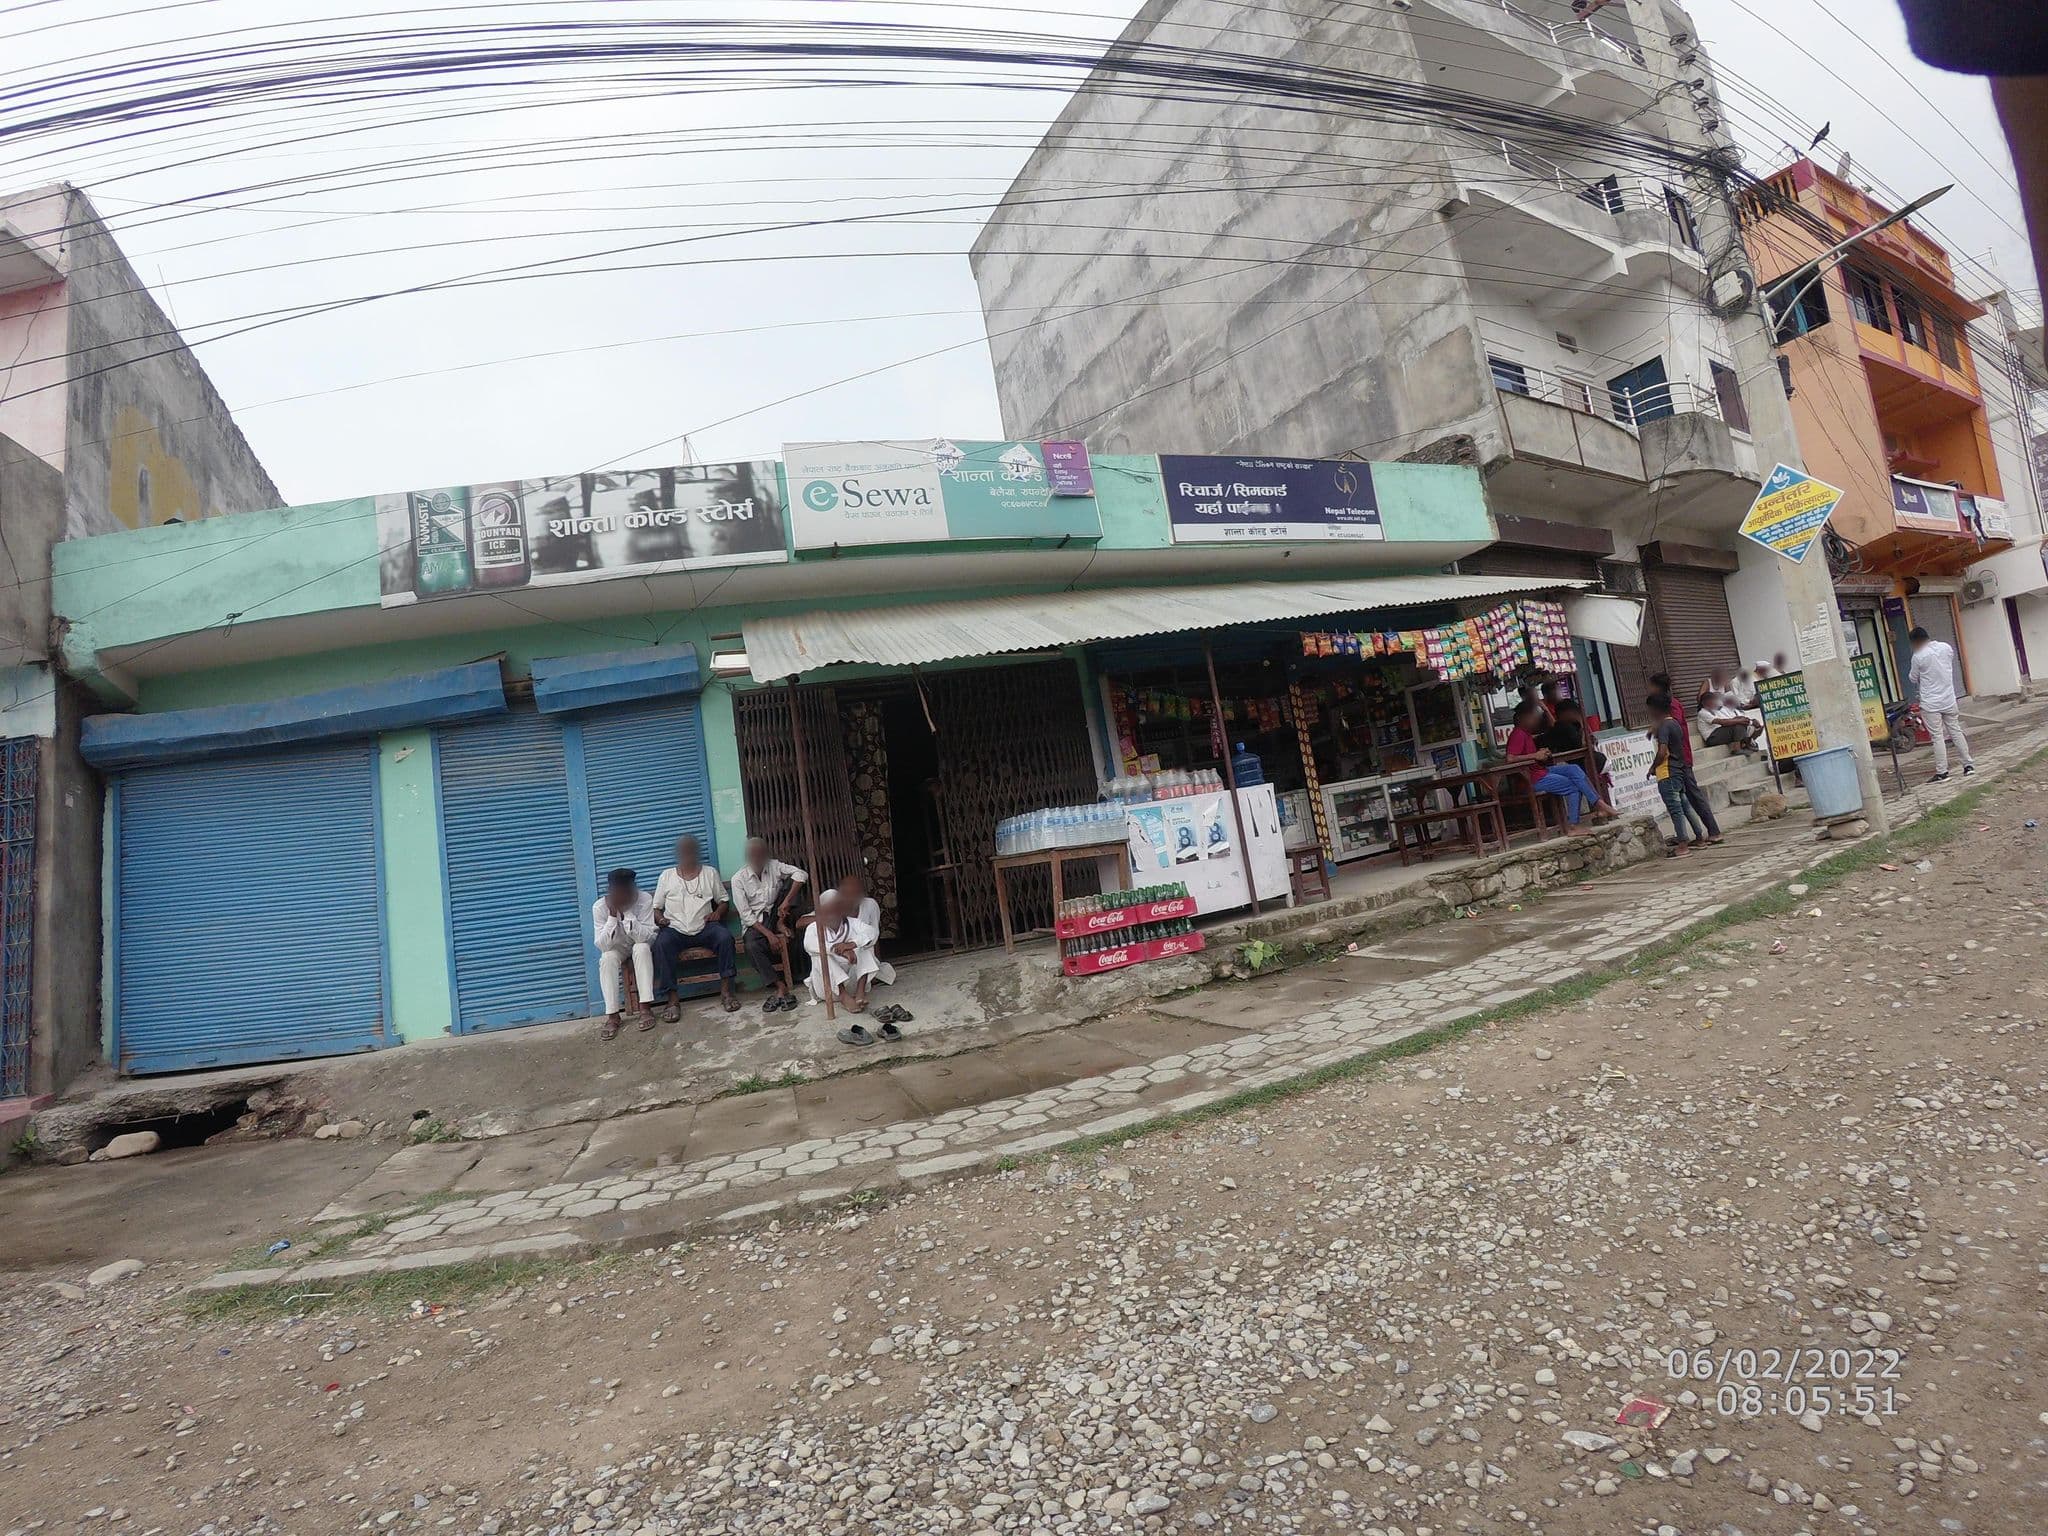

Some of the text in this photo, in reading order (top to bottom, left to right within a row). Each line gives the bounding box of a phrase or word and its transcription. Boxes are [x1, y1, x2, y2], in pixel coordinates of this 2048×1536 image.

[803, 479, 931, 511] eSewa
[418, 502, 430, 545] NAMASTE
[549, 514, 616, 537] शान्ता
[624, 505, 688, 529] कोल्ड
[1324, 507, 1376, 516] Nepal Telecom
[489, 540, 506, 550] ICE
[1761, 668, 1871, 701] WE ORGANIZE FOR
[1769, 678, 1790, 691] NEPAL
[1790, 674, 1804, 685] TOU
[1858, 657, 1873, 668] LTD
[1763, 698, 1793, 712] NEPAL
[1604, 739, 1630, 758] NEPAL
[1773, 739, 1814, 757] SIM CARD
